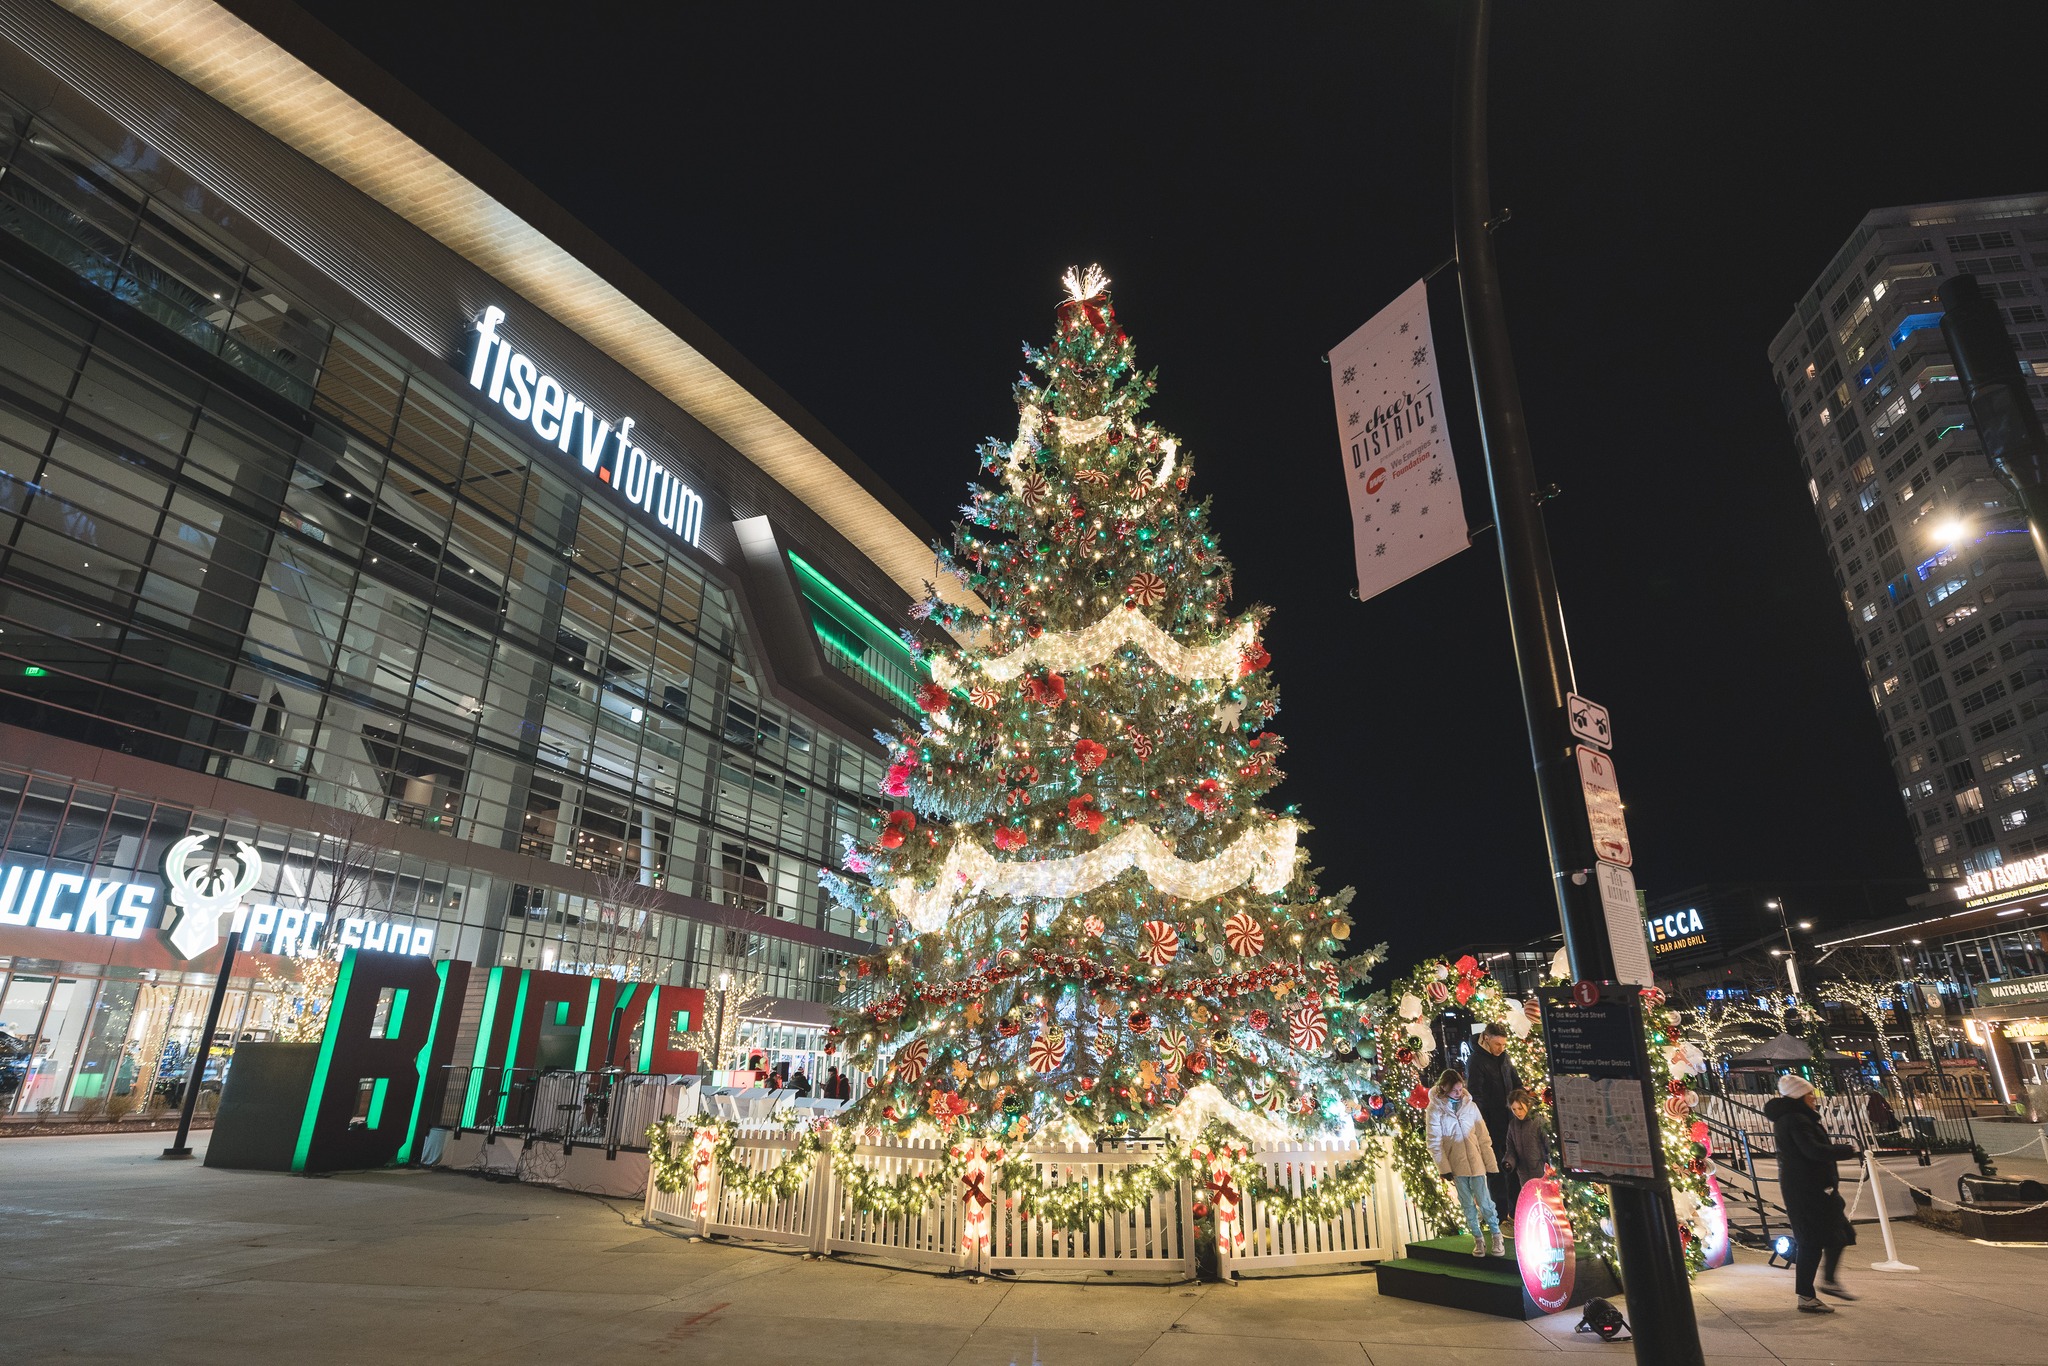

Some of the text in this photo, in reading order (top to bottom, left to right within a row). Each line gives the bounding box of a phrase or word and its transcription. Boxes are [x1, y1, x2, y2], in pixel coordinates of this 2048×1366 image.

[1365, 390, 1416, 433] cheer
[1352, 391, 1434, 469] DISTRICT
[1390, 439, 1432, 469] We Energies
[1392, 451, 1431, 480] Foundation
[612, 416, 704, 548] forum
[1590, 759, 1603, 776] NO
[1966, 869, 1994, 895] NEW
[0, 865, 155, 940] UCKS
[1660, 942, 1674, 953] BAR
[1673, 939, 1687, 950] AND
[1687, 934, 1707, 946] GRILL
[1990, 984, 2021, 998] WATCH
